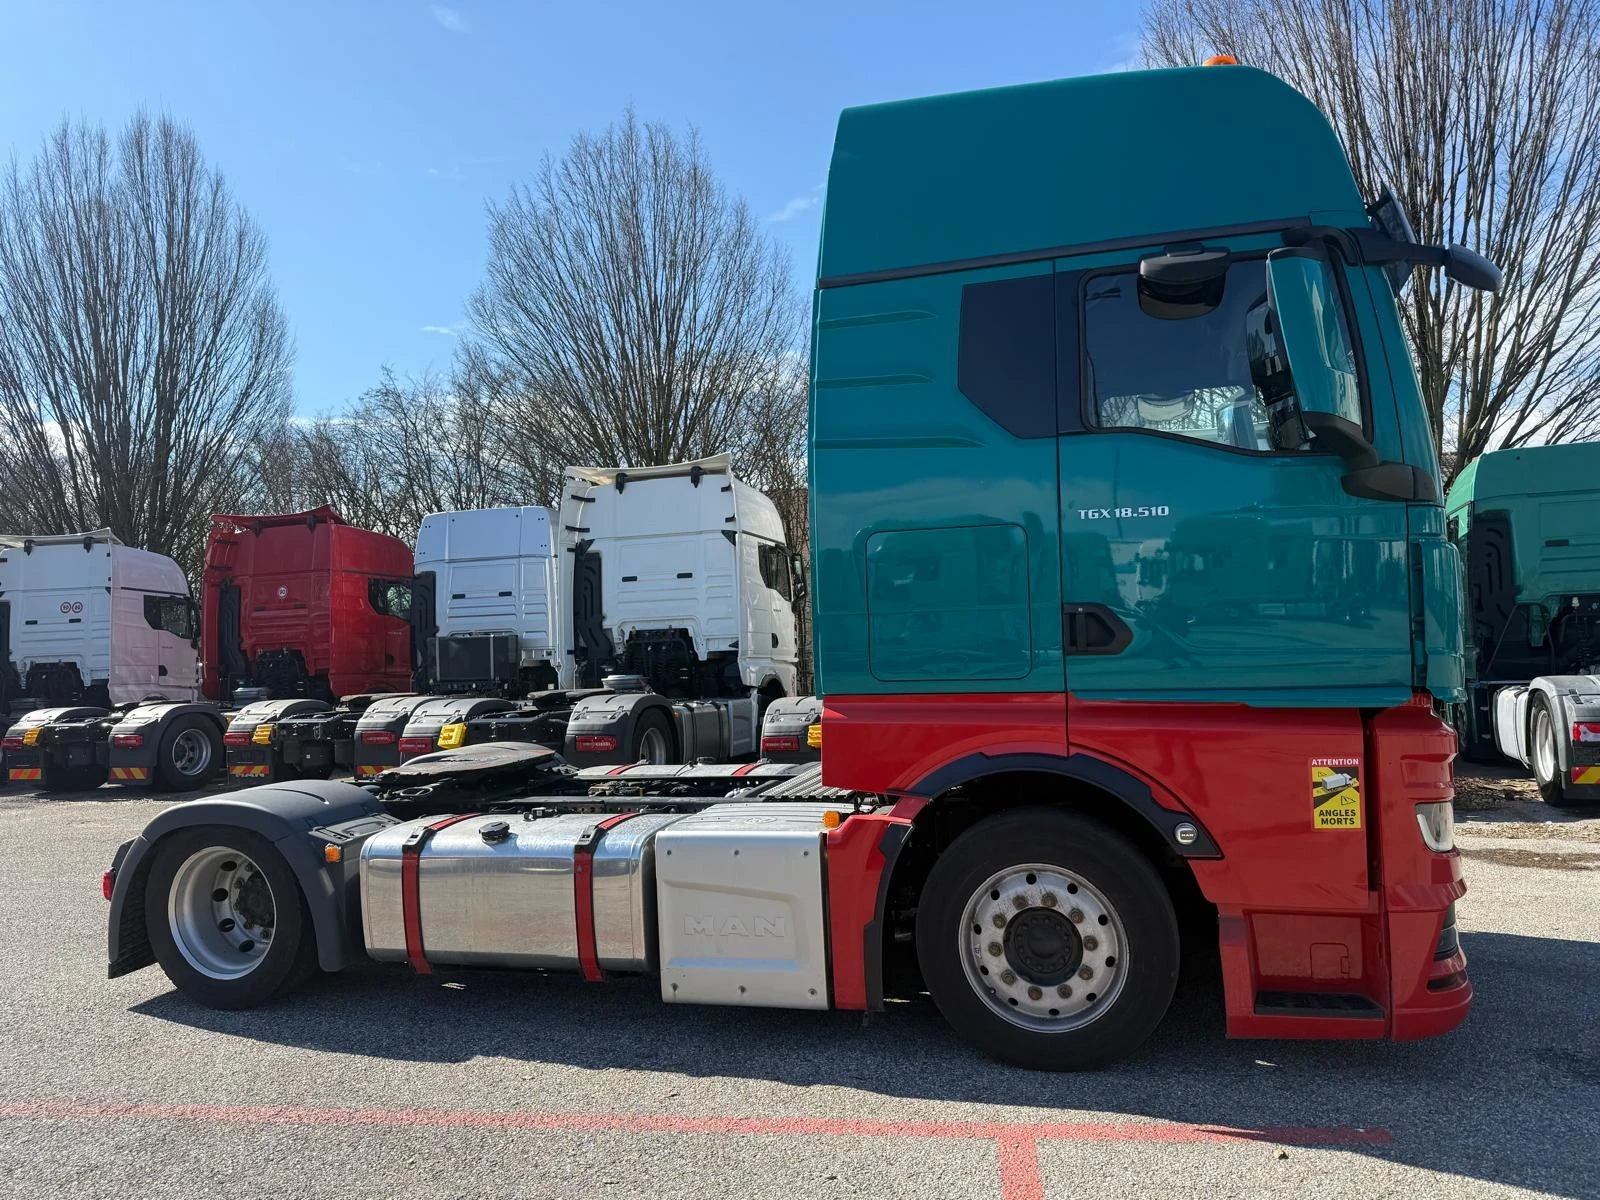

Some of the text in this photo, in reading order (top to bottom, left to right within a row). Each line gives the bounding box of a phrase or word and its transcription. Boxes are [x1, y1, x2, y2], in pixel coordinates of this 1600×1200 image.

[1077, 505, 1169, 520] TGX 18.510
[1311, 758, 1359, 766] ATTENTION
[1318, 809, 1356, 817] ANGLES
[1321, 817, 1355, 825] MORTS
[681, 913, 785, 938] MAN
